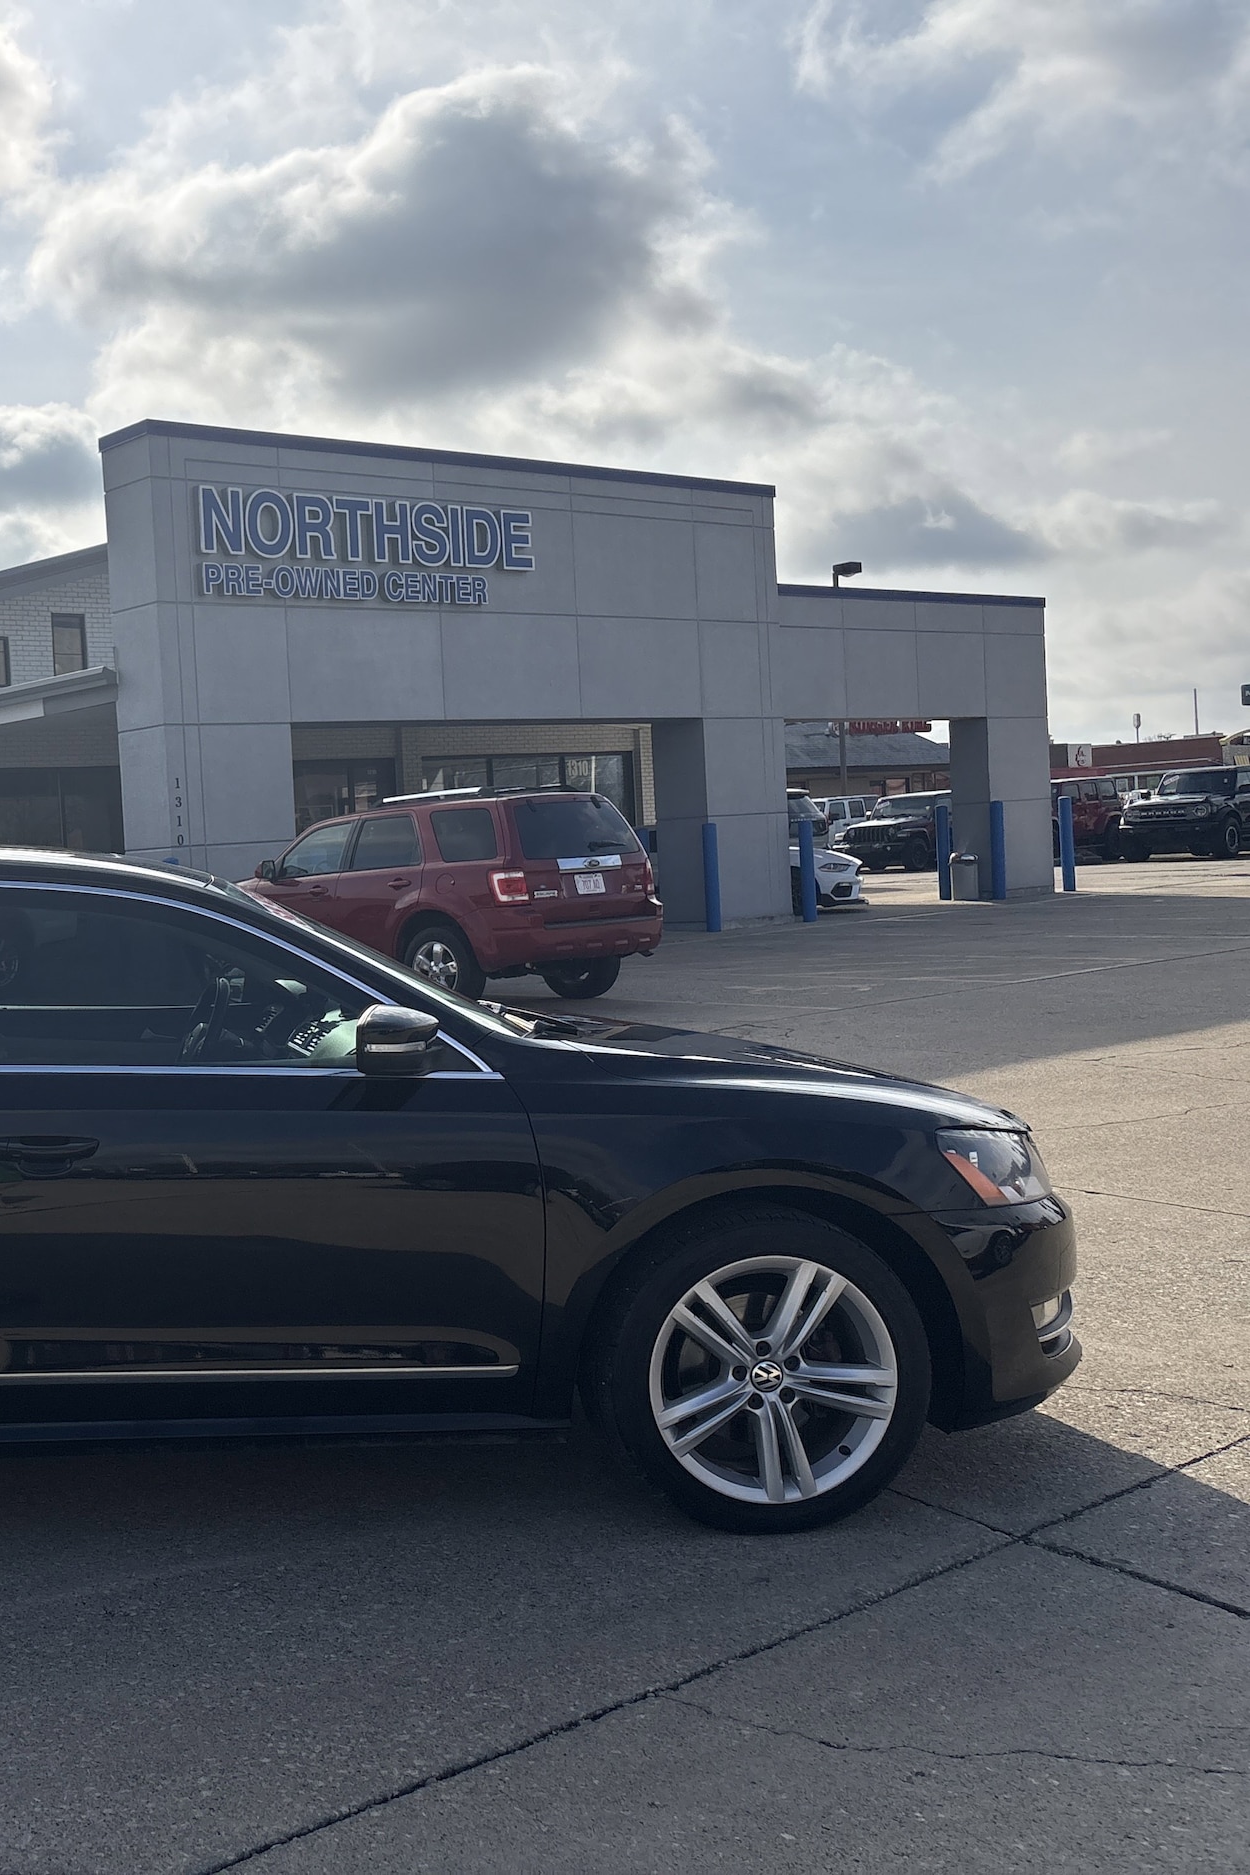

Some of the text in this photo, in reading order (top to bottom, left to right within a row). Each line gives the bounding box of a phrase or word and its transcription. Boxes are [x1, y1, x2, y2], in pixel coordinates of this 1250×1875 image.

[198, 485, 535, 571] NORTHSIDE
[203, 562, 489, 604] PRE-OWNED CENTER
[566, 760, 589, 776] 1310
[175, 777, 184, 846] 1310
